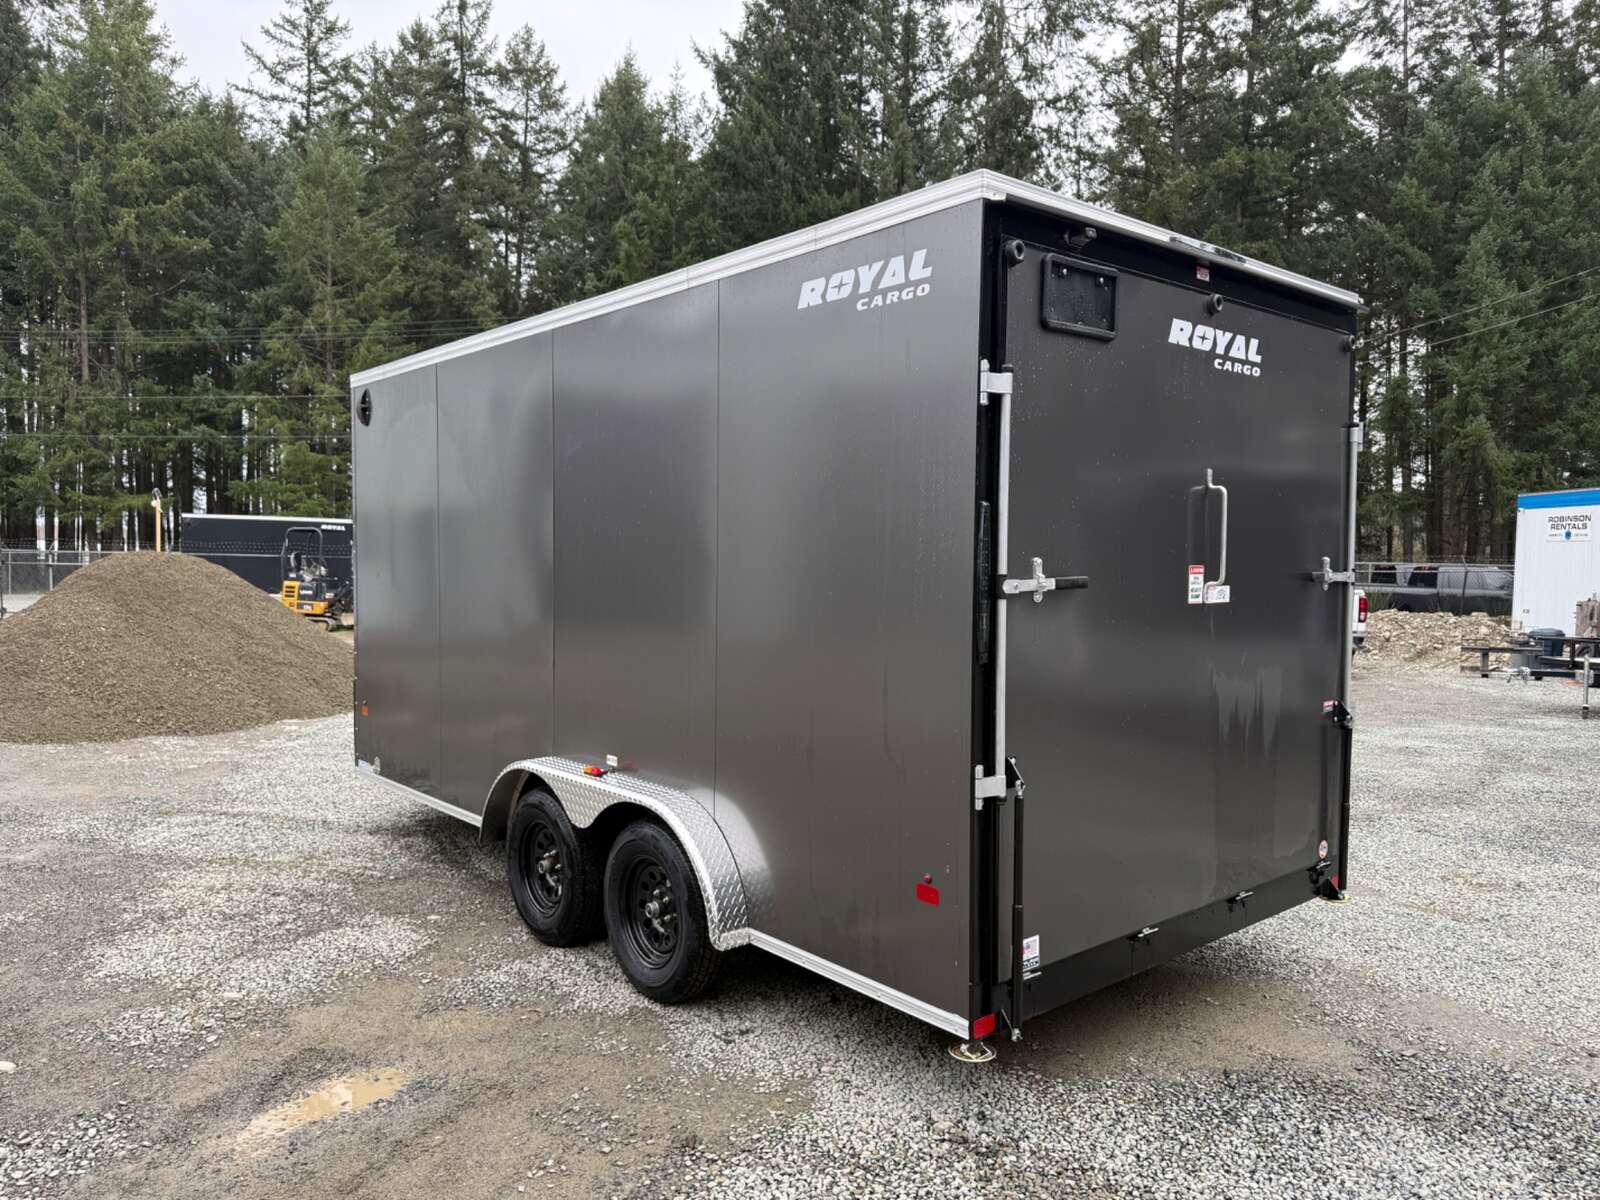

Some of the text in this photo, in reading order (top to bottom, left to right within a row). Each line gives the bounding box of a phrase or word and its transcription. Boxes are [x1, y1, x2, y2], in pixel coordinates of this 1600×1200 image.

[797, 248, 933, 310] ROYAL
[856, 283, 931, 311] CARGO
[1168, 318, 1262, 363] ROYAL
[1214, 358, 1261, 377] CARGO
[1547, 514, 1592, 523] ROBINSON
[1550, 522, 1588, 530] RENTALS
